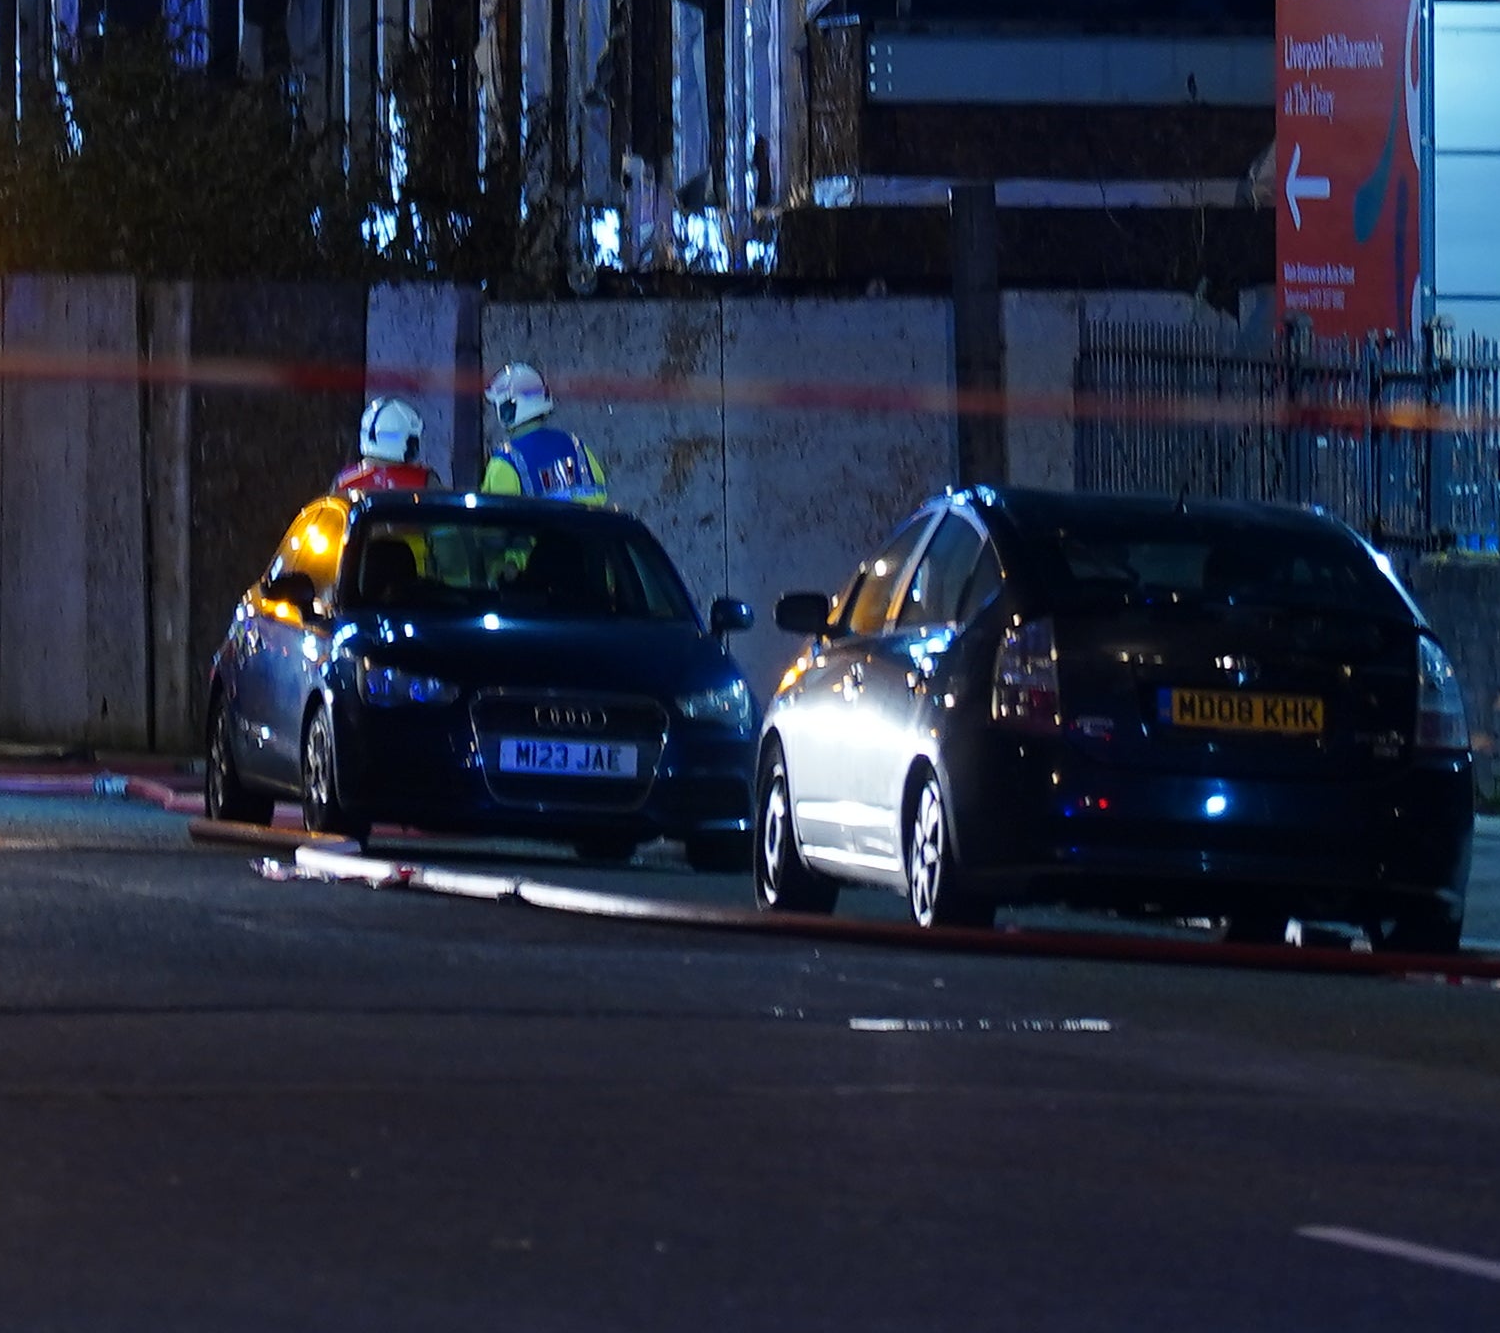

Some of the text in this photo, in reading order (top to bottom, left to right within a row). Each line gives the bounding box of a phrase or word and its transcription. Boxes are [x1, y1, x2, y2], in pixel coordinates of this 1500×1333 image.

[1283, 33, 1384, 78] Liverpool Philharmonic
[515, 739, 569, 769] M123
